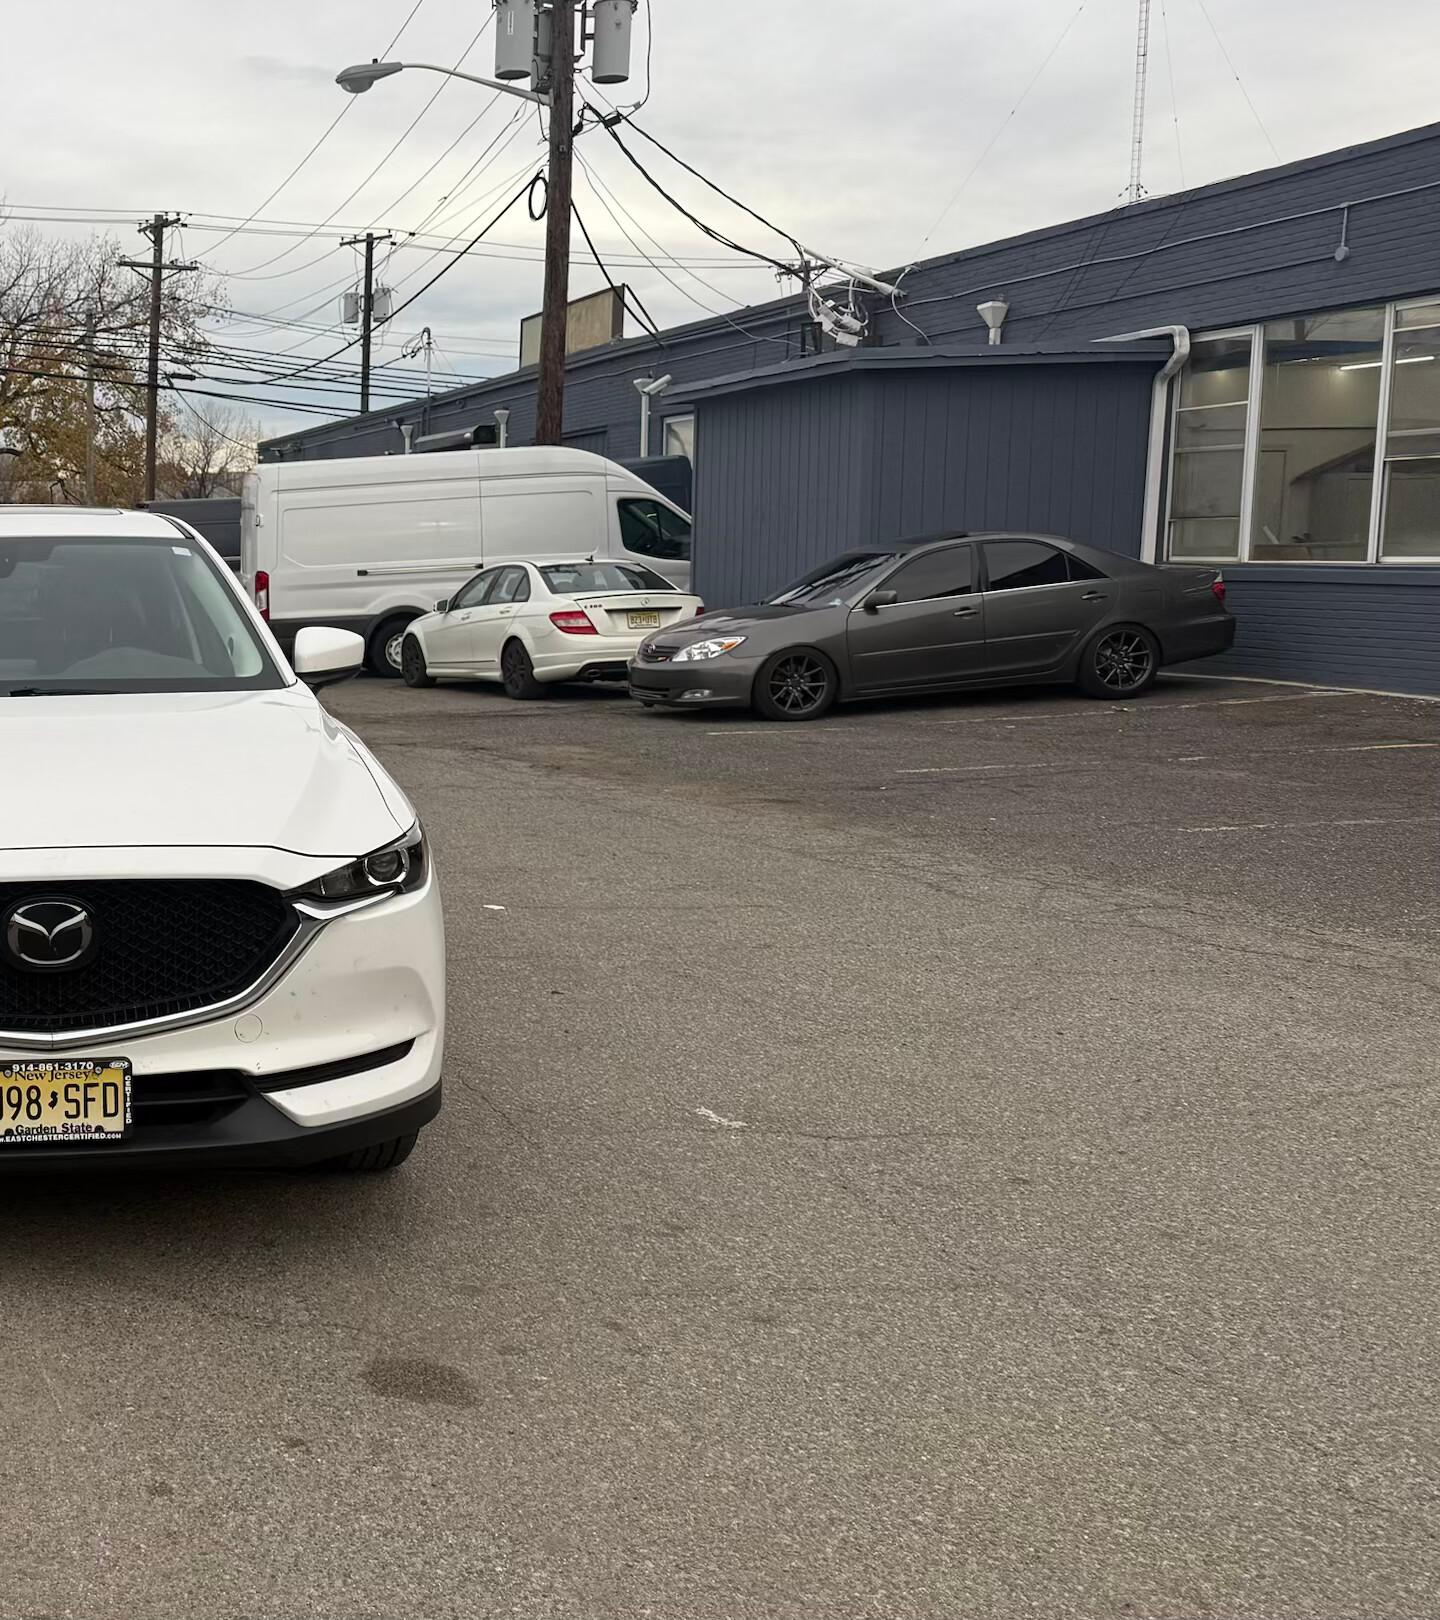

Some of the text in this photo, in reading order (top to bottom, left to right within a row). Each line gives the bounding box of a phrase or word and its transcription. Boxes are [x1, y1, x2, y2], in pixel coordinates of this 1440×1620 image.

[12, 1061, 94, 1072] 914-861-3170
[14, 1070, 91, 1083] New Jersey
[64, 1082, 119, 1119] SFD
[124, 1075, 132, 1124] CERTIFIED
[15, 1122, 93, 1135] Garden State
